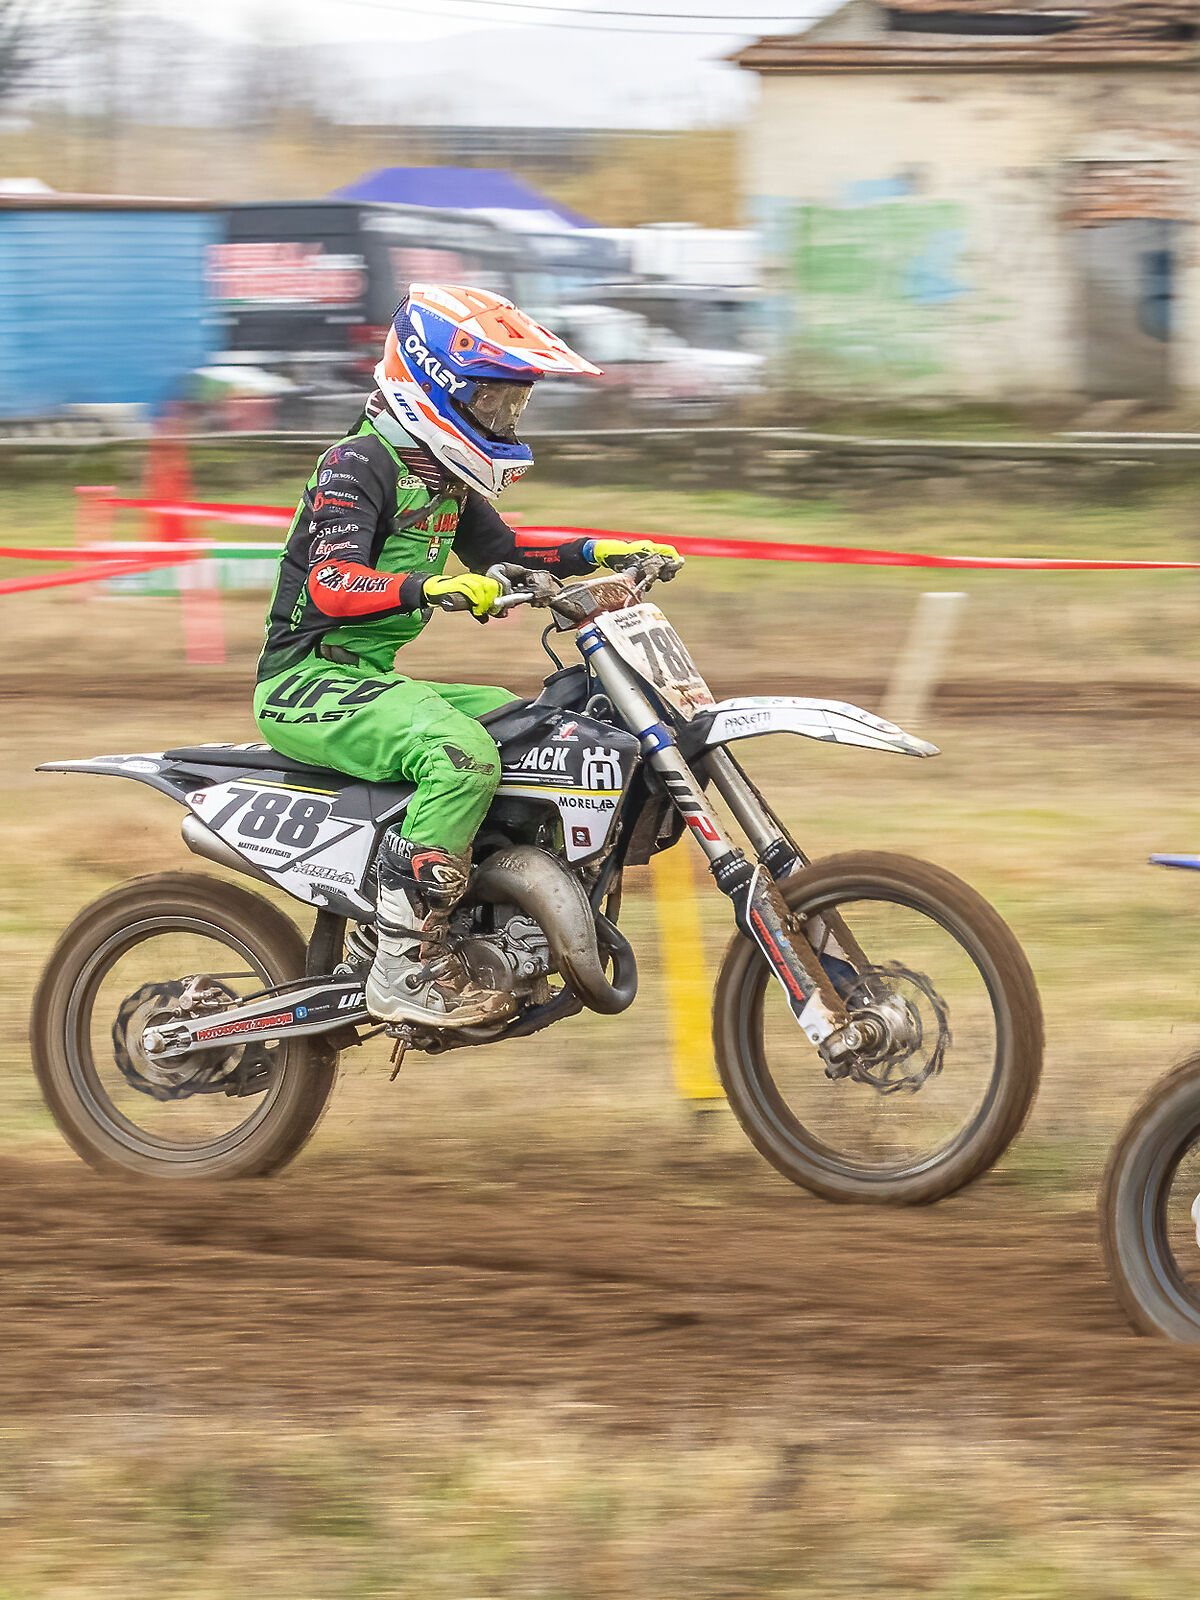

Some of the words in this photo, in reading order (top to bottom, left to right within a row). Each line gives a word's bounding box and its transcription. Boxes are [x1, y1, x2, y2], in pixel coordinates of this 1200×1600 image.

[404, 335, 468, 395] OAKLEY
[393, 392, 420, 423] UFO
[345, 575, 394, 593] JACK
[265, 673, 406, 709] UFO
[208, 787, 333, 850] 788
[558, 796, 616, 810] MORELAB
